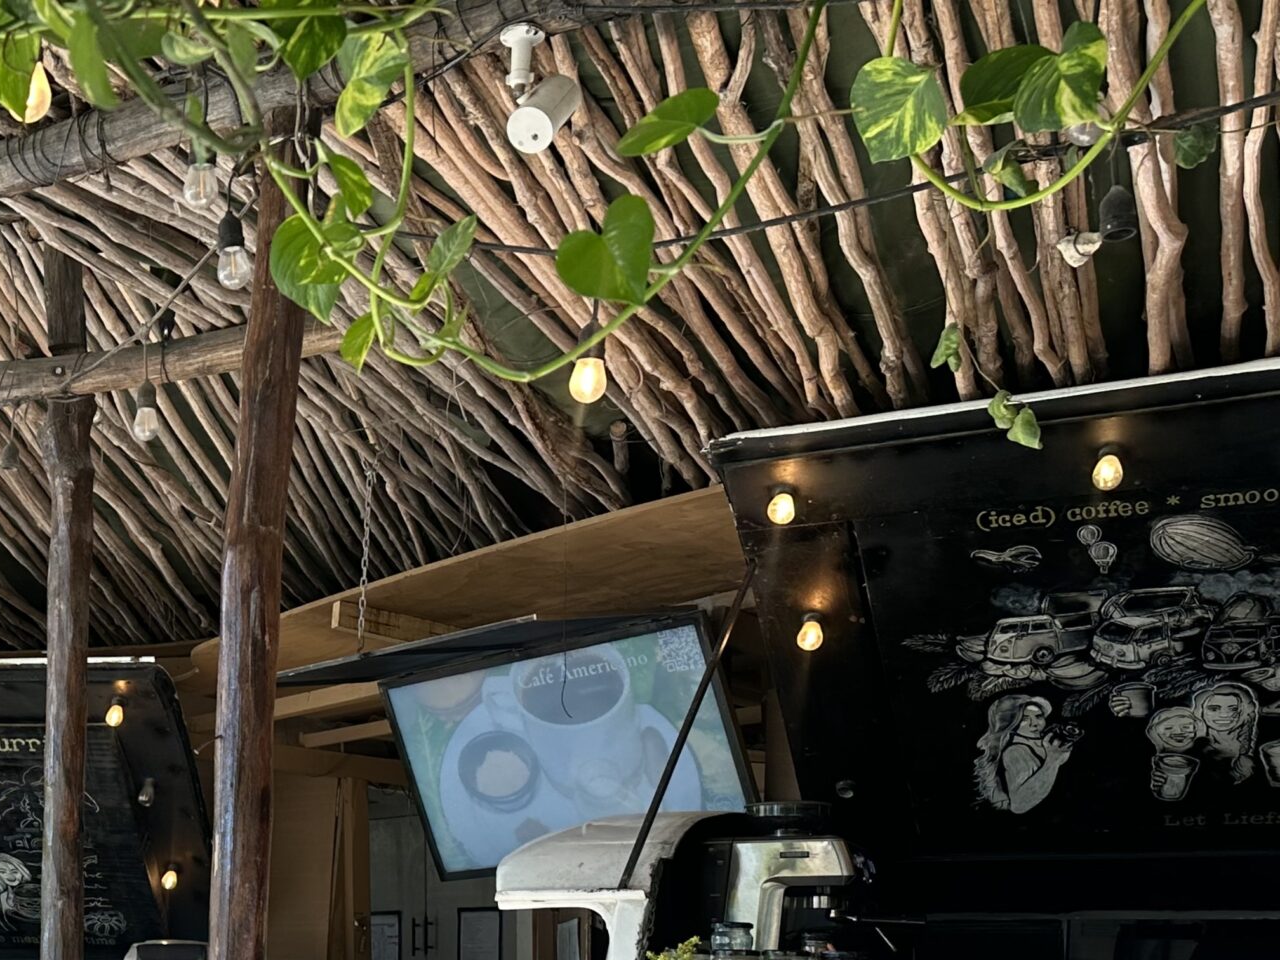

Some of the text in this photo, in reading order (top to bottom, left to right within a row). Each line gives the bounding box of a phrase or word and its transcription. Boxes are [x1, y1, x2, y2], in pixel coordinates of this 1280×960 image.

[975, 487, 1280, 533] (iced) coffee smoo
[518, 667, 554, 690] Café
[1163, 813, 1207, 827] Let
[11, 935, 40, 945] mea
